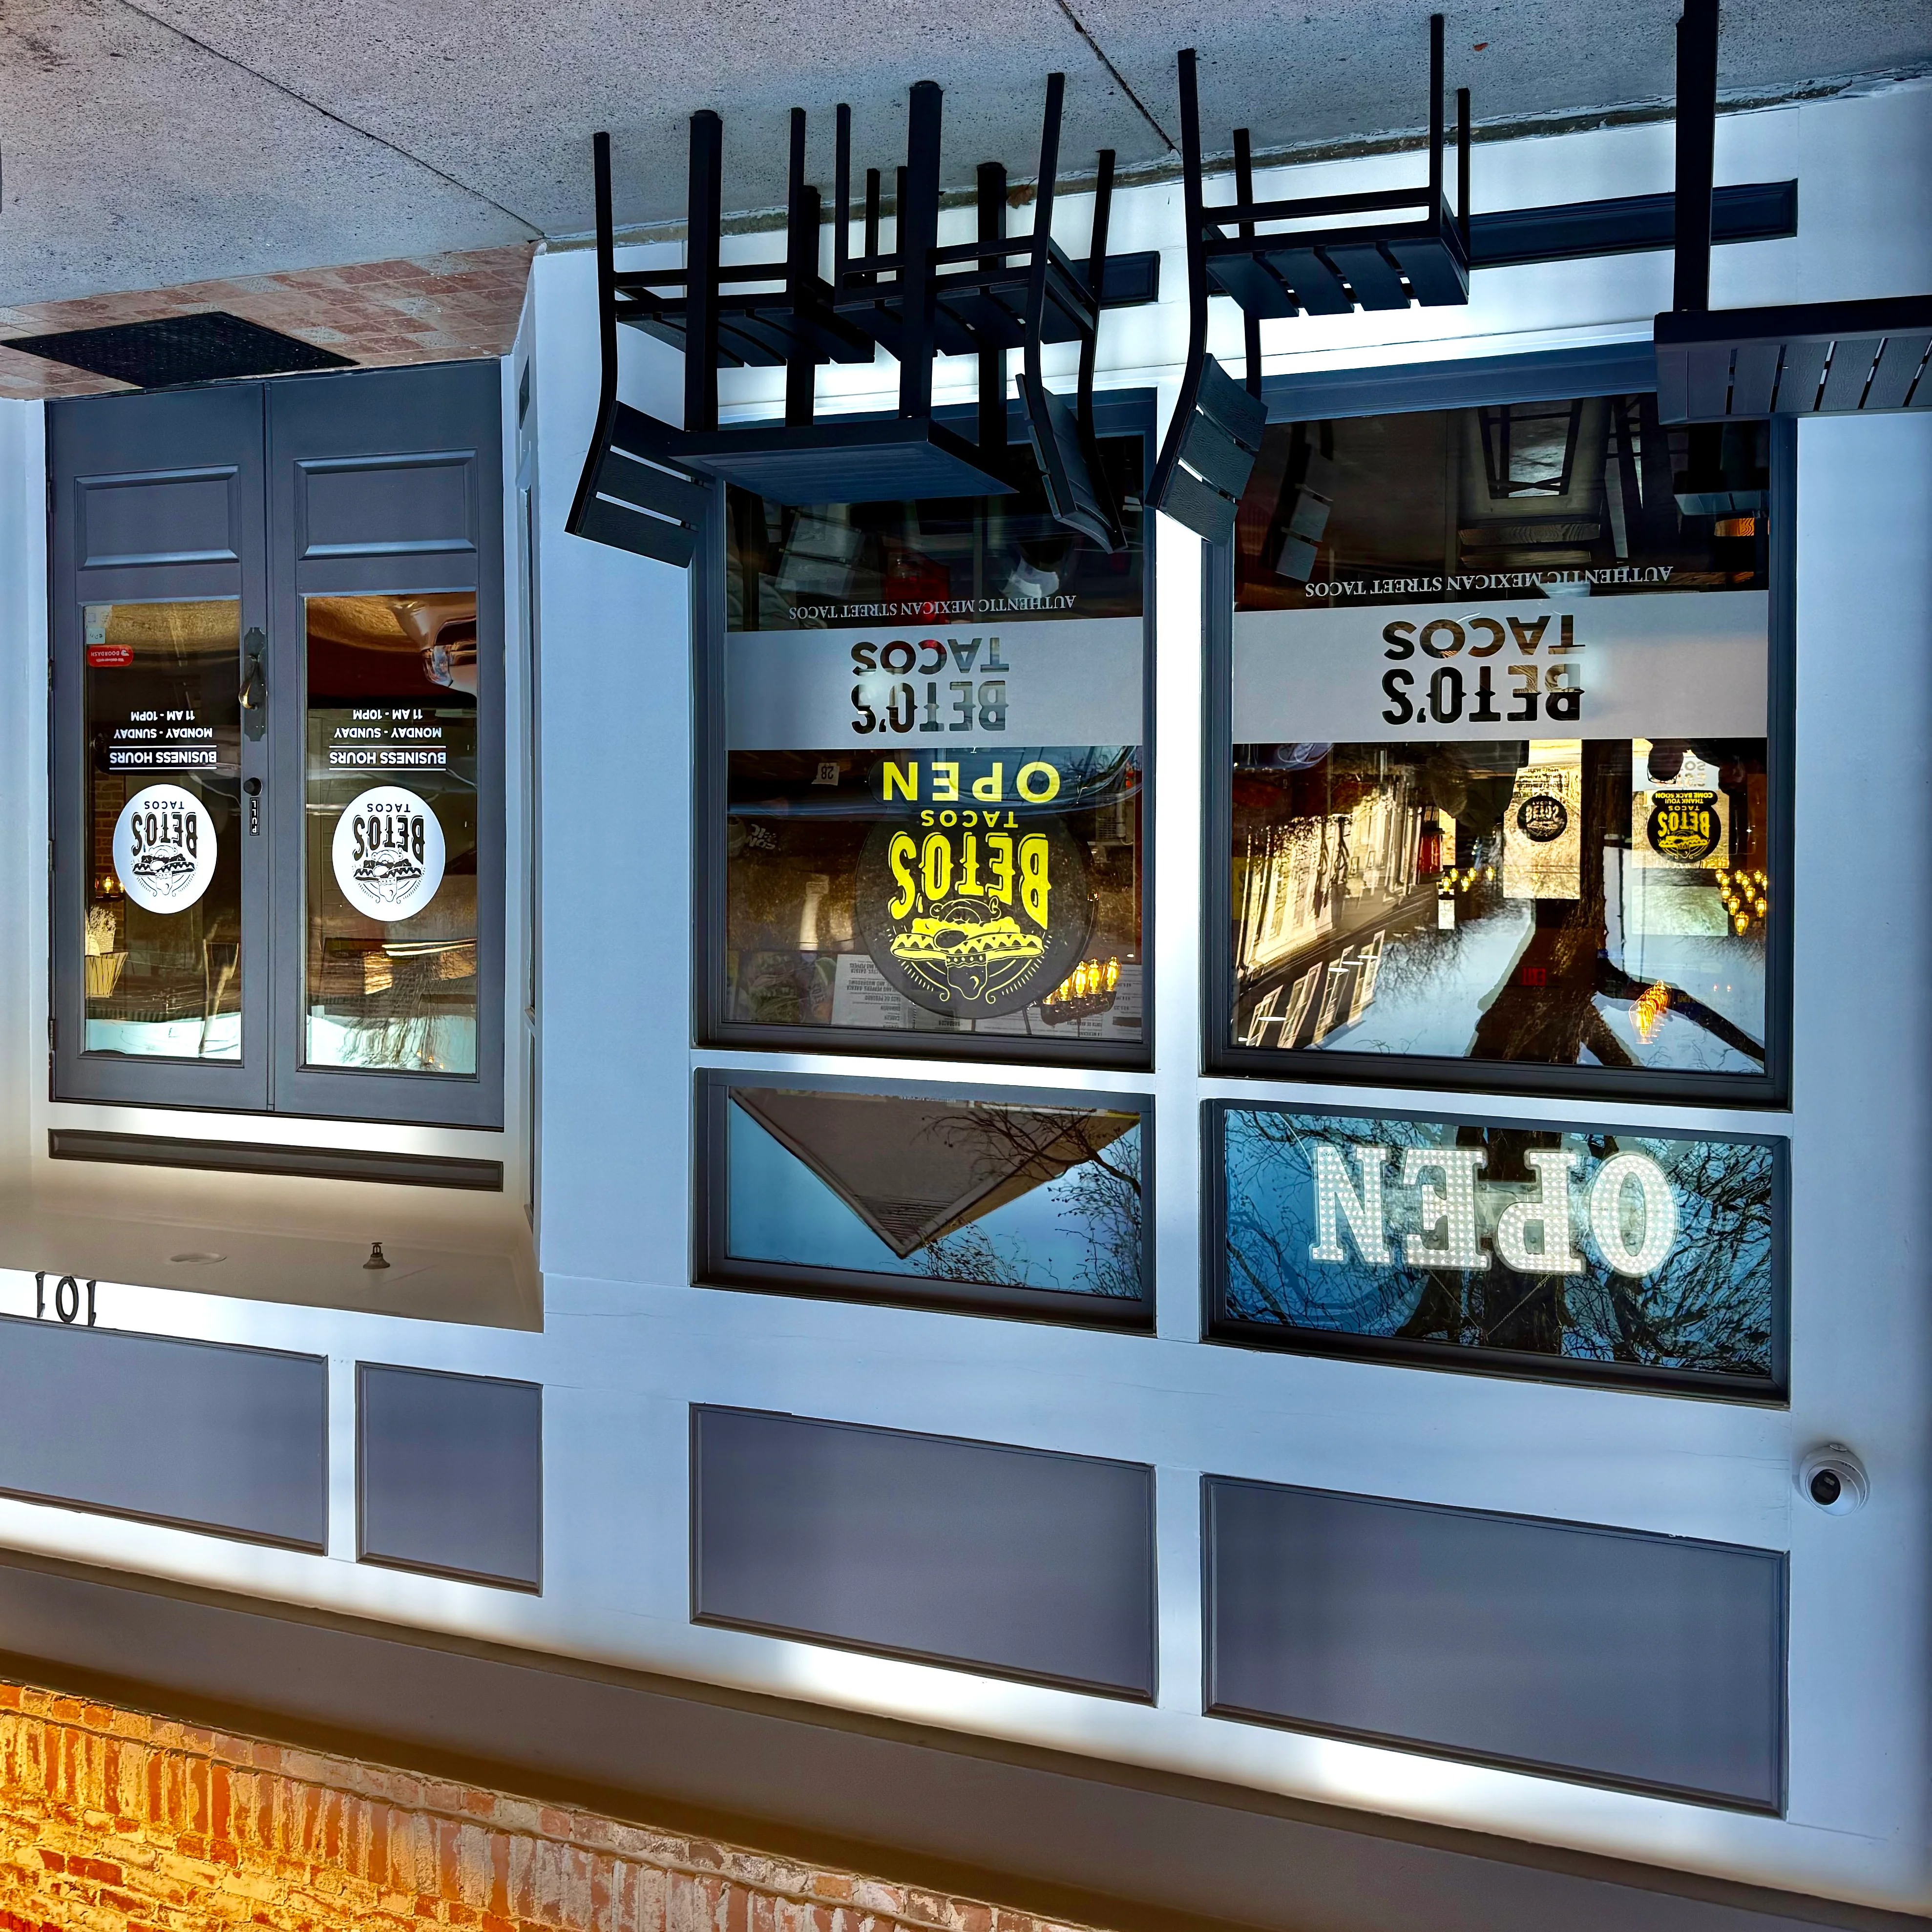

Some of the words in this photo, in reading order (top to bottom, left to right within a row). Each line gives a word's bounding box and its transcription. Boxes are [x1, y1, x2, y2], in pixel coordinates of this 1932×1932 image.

[1446, 572, 1541, 591] MEXICAN
[1547, 566, 1673, 585] AUTHENTIC
[1305, 581, 1366, 597] TACOS
[1370, 577, 1442, 594] STREET
[840, 603, 897, 618] STREET
[901, 599, 975, 615] MEXICAN
[978, 595, 1076, 612] AUTHENTIC
[789, 606, 838, 619] TACOS
[1382, 615, 1585, 660] TACOS
[851, 637, 1009, 675] TACOS
[1381, 664, 1585, 725] BETO'S
[353, 709, 382, 720] 10PM
[392, 709, 410, 720] AM
[413, 709, 423, 719] 11
[851, 680, 1009, 734] BETO'S
[130, 711, 158, 721] 10PM
[167, 711, 183, 721] AM
[186, 711, 195, 720] 11
[114, 729, 157, 739] SUNDAY
[166, 728, 212, 738] MONDAY
[334, 728, 381, 738] SUNDAY
[391, 727, 441, 738] MONDAY
[110, 752, 152, 764] HOURS
[156, 751, 217, 763] BUSINESS
[330, 752, 377, 764] HOURS
[380, 752, 446, 764] BUSINESS
[821, 766, 834, 779] 28
[883, 762, 1060, 803] OPEN
[144, 801, 184, 809] TACOS
[367, 803, 411, 813] TACOS
[921, 810, 1018, 828] TACOS
[1658, 811, 1710, 838] BETO'S
[131, 812, 198, 859] BETO'S
[352, 815, 425, 865] BETO'S
[888, 831, 1051, 929] BETO'S
[1309, 1146, 1679, 1277] OPEN
[35, 1271, 96, 1327] 101
